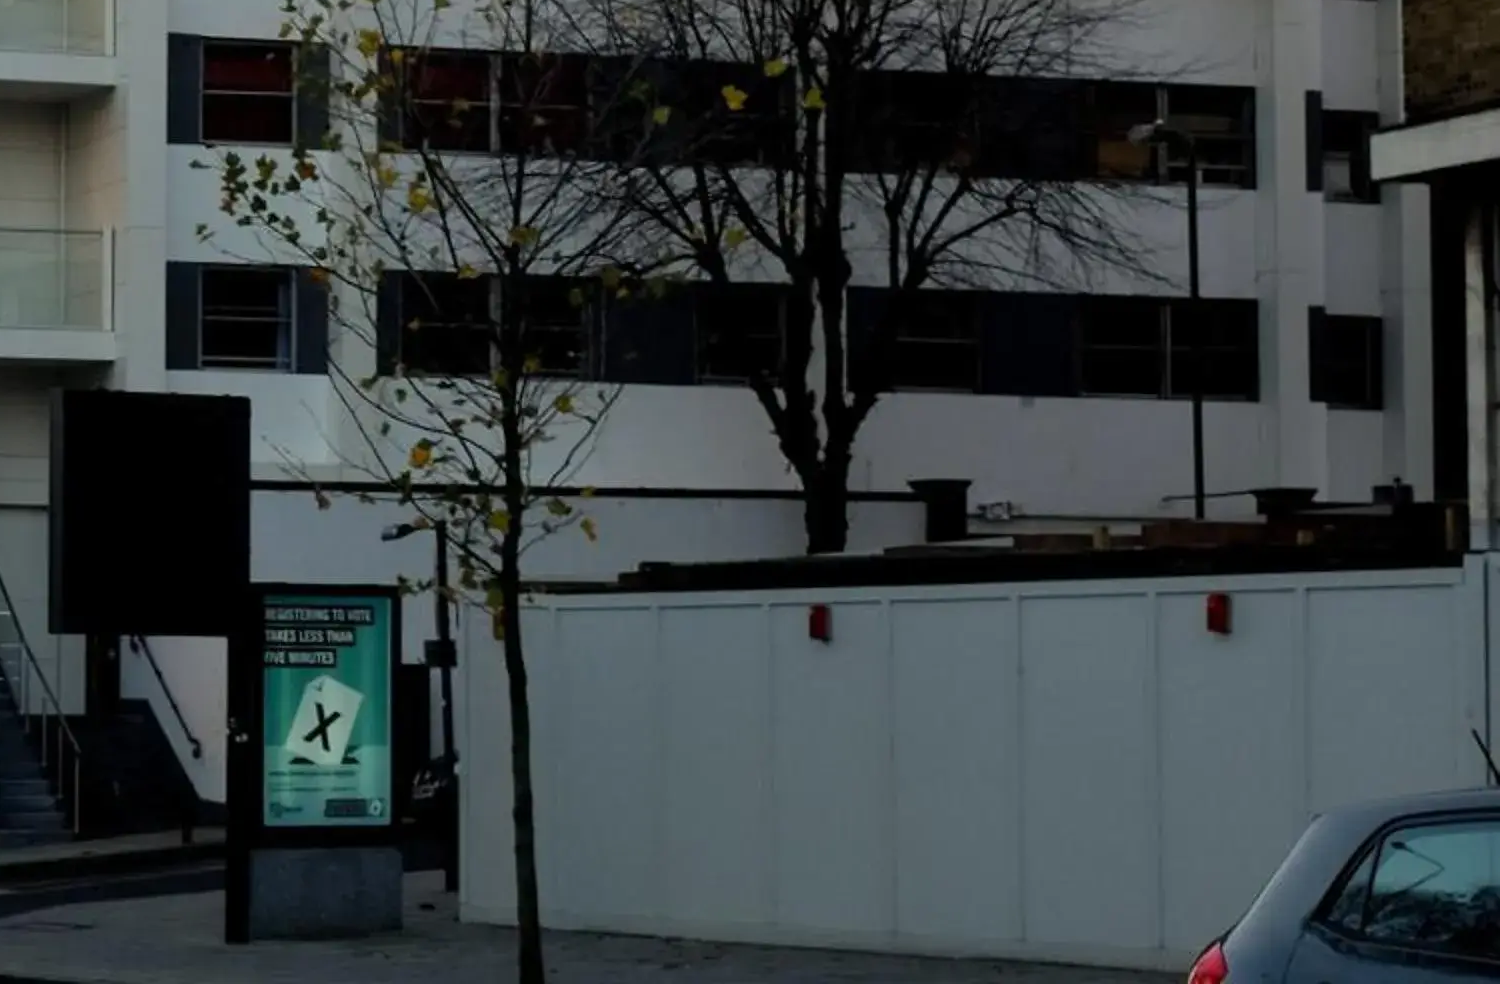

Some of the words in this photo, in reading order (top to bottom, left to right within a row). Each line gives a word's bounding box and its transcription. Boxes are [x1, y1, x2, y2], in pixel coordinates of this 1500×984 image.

[333, 607, 345, 621] TO
[265, 629, 296, 642] TAKES
[299, 630, 324, 642] LESS
[326, 630, 353, 643] THAN
[264, 651, 285, 664] FIVE
[288, 651, 335, 664] MINUTES
